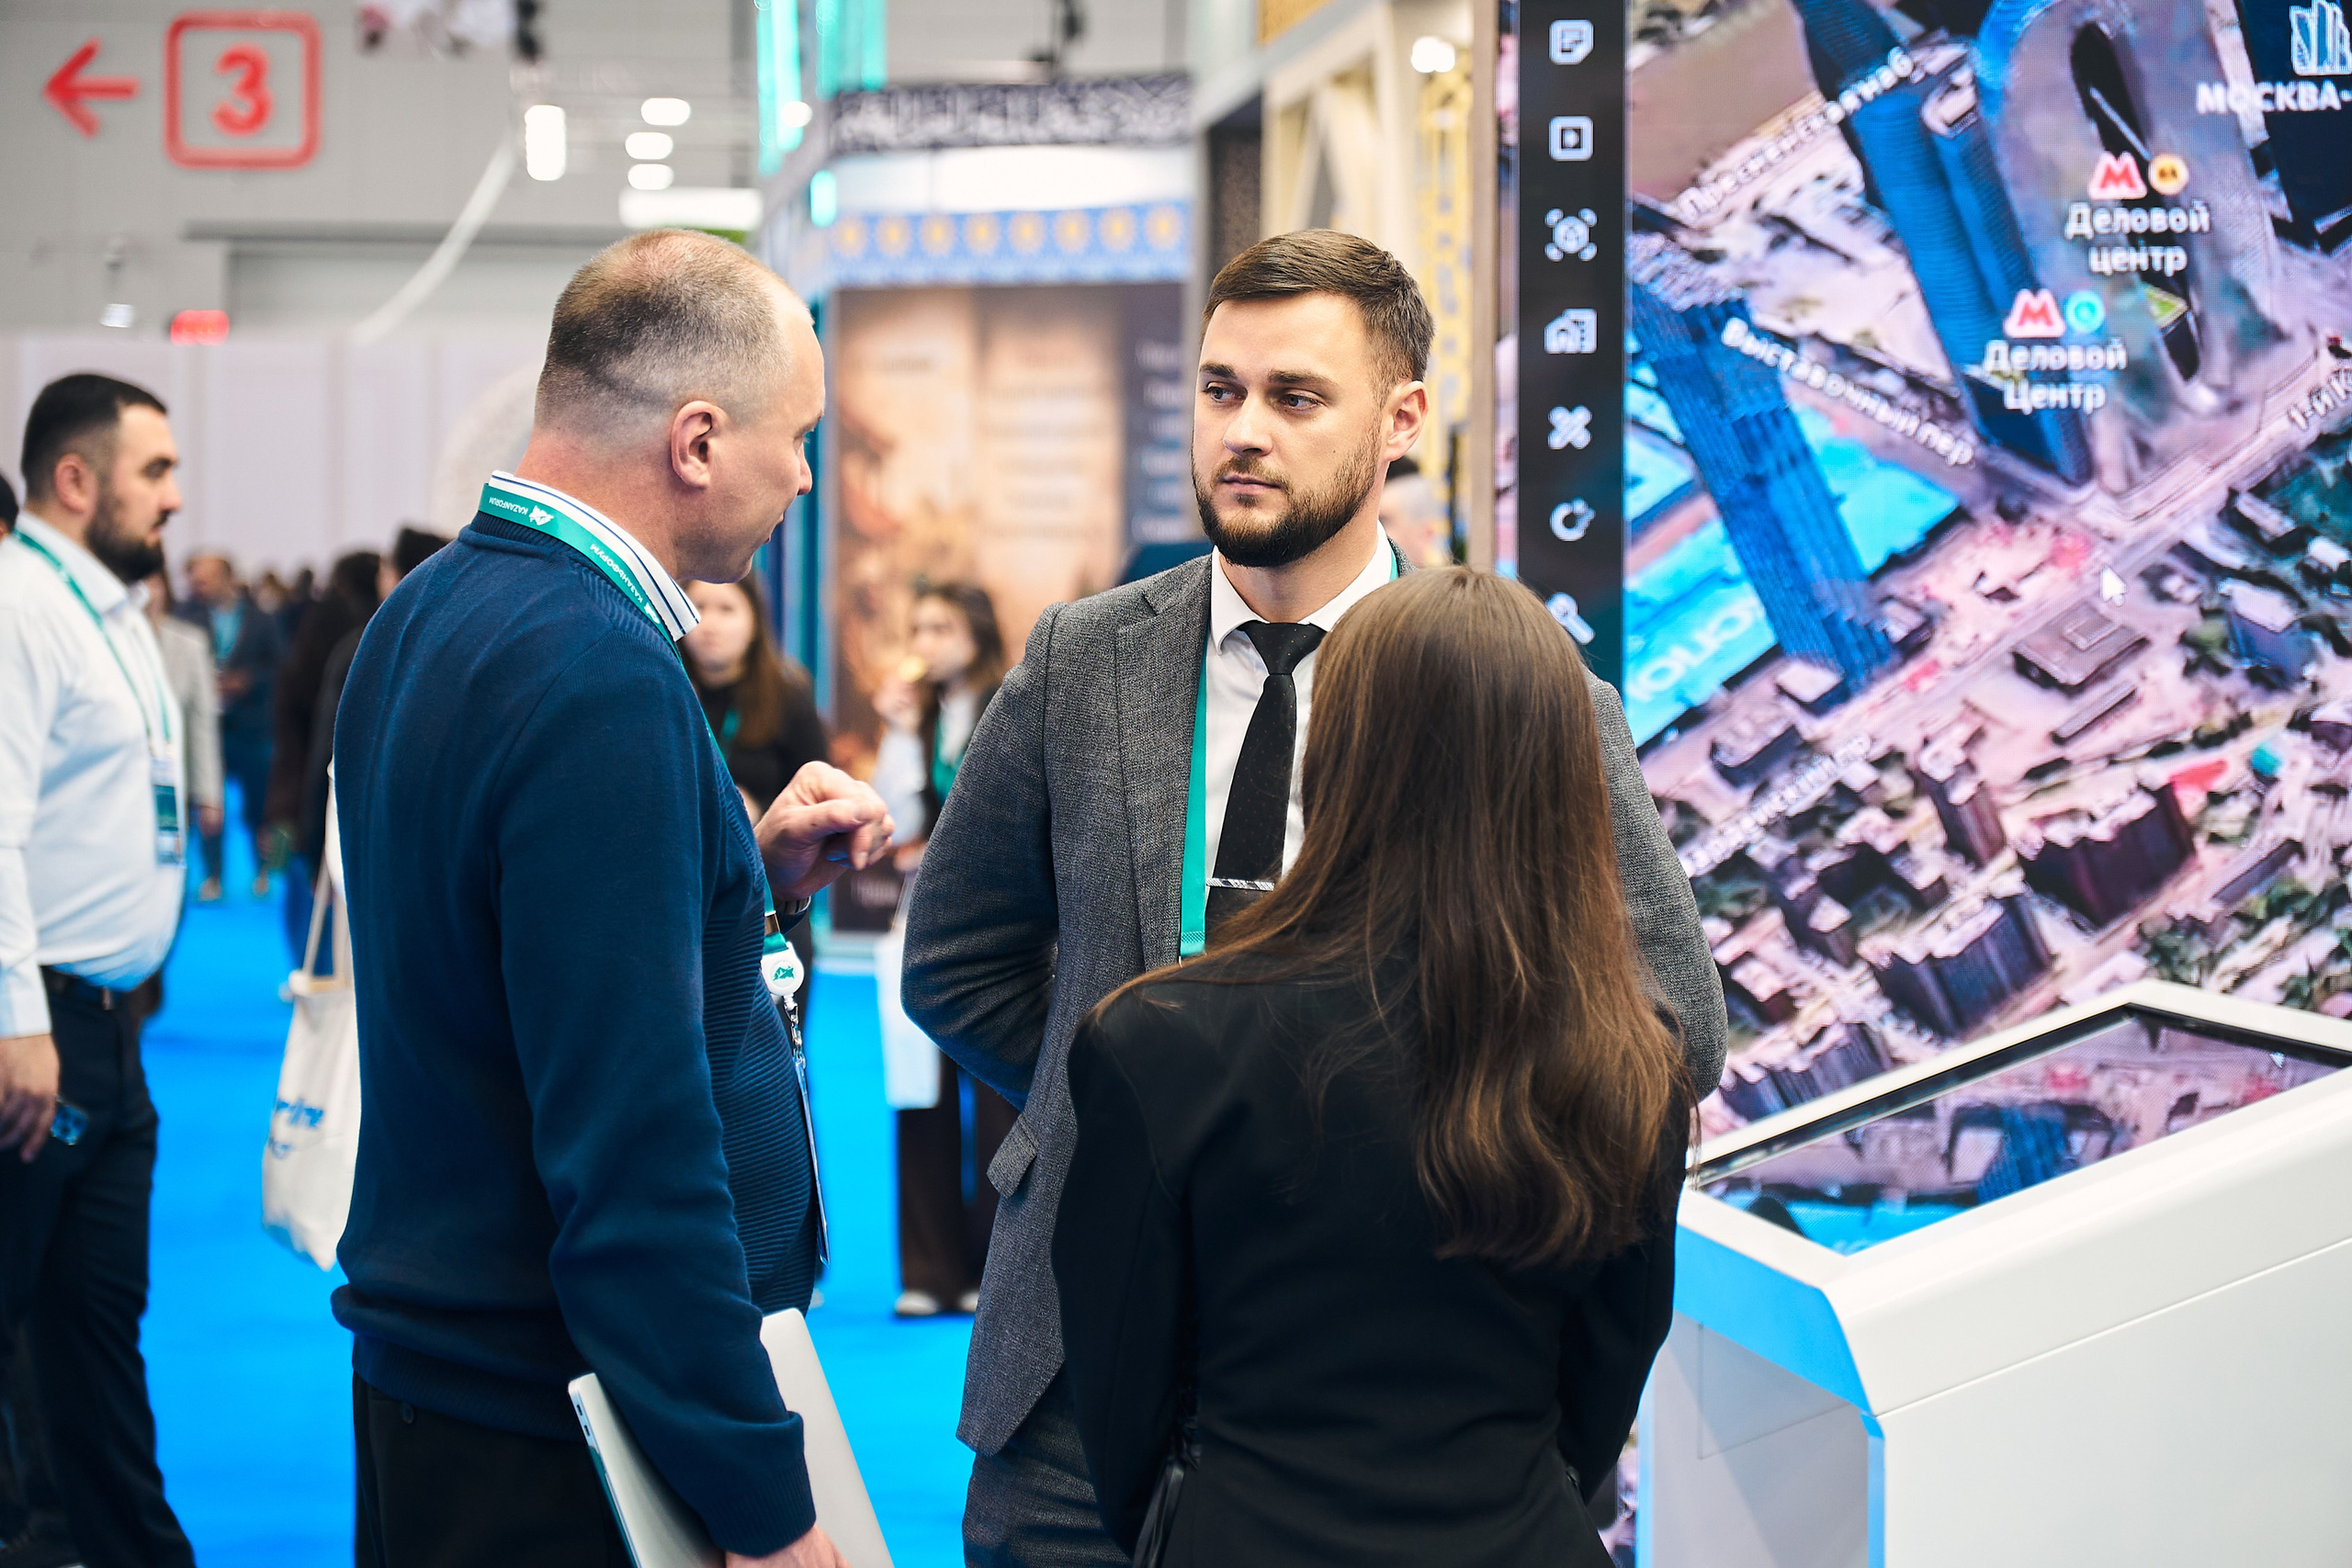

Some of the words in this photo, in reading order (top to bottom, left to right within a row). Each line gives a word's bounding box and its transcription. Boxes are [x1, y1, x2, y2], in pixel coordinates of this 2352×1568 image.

[210, 41, 274, 138] 3
[2064, 199, 2211, 241] Деловой
[2088, 245, 2188, 277] центр
[1983, 337, 2128, 372] Деловой
[1721, 317, 1920, 437] Выставочный
[2004, 378, 2106, 415] Центр
[489, 496, 528, 516] KAZANFORUM
[589, 543, 643, 604] КАЗАНЬФОРУМ
